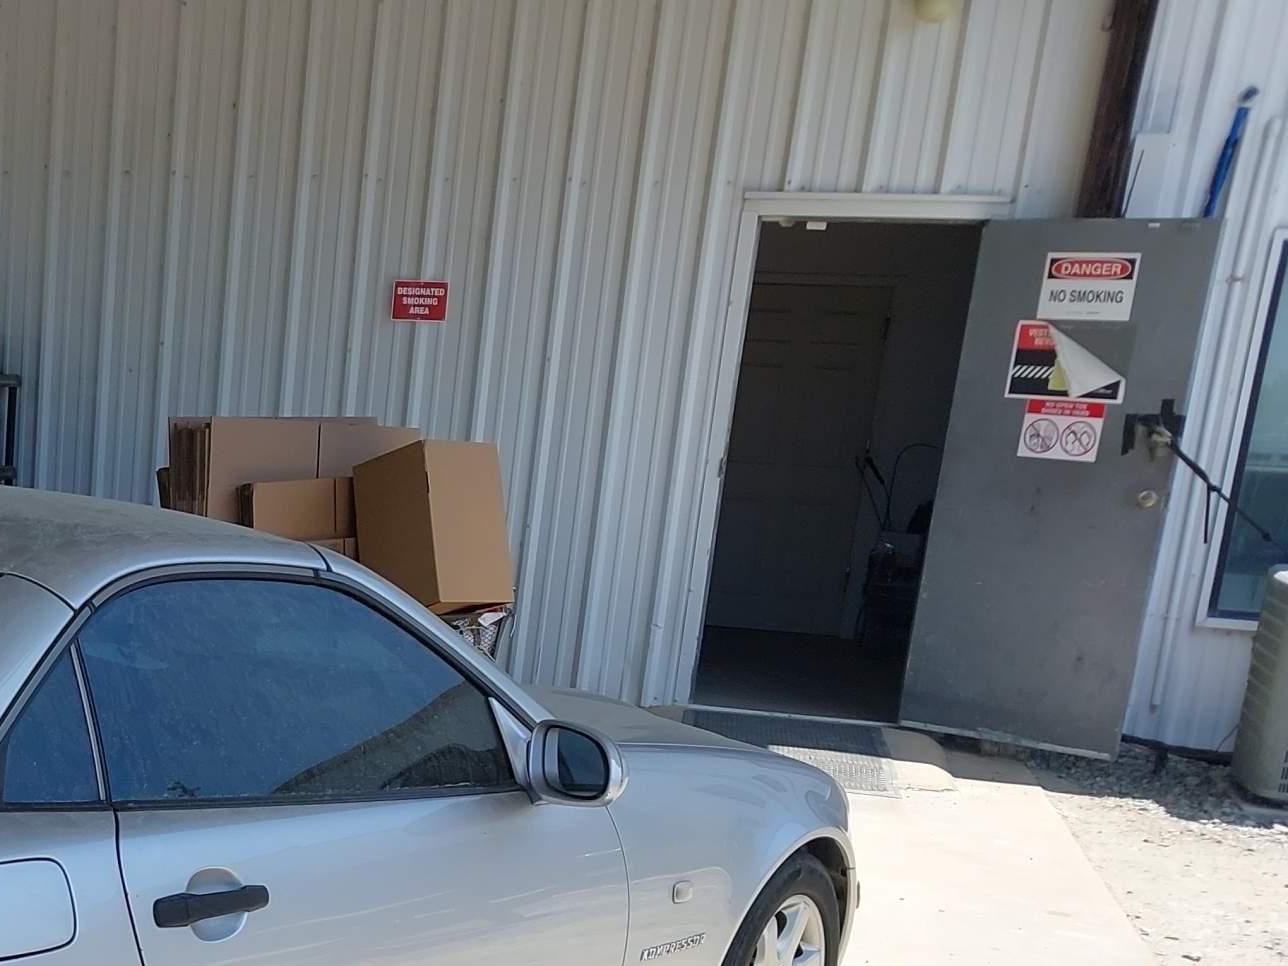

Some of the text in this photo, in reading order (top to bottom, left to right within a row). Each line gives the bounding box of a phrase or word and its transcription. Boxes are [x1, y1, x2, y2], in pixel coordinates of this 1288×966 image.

[1060, 262, 1122, 275] DANGER
[397, 287, 445, 296] DESIGNATED
[1048, 289, 1124, 304] NO SMOKING
[402, 296, 438, 306] SMOKING
[409, 306, 430, 315] AREA
